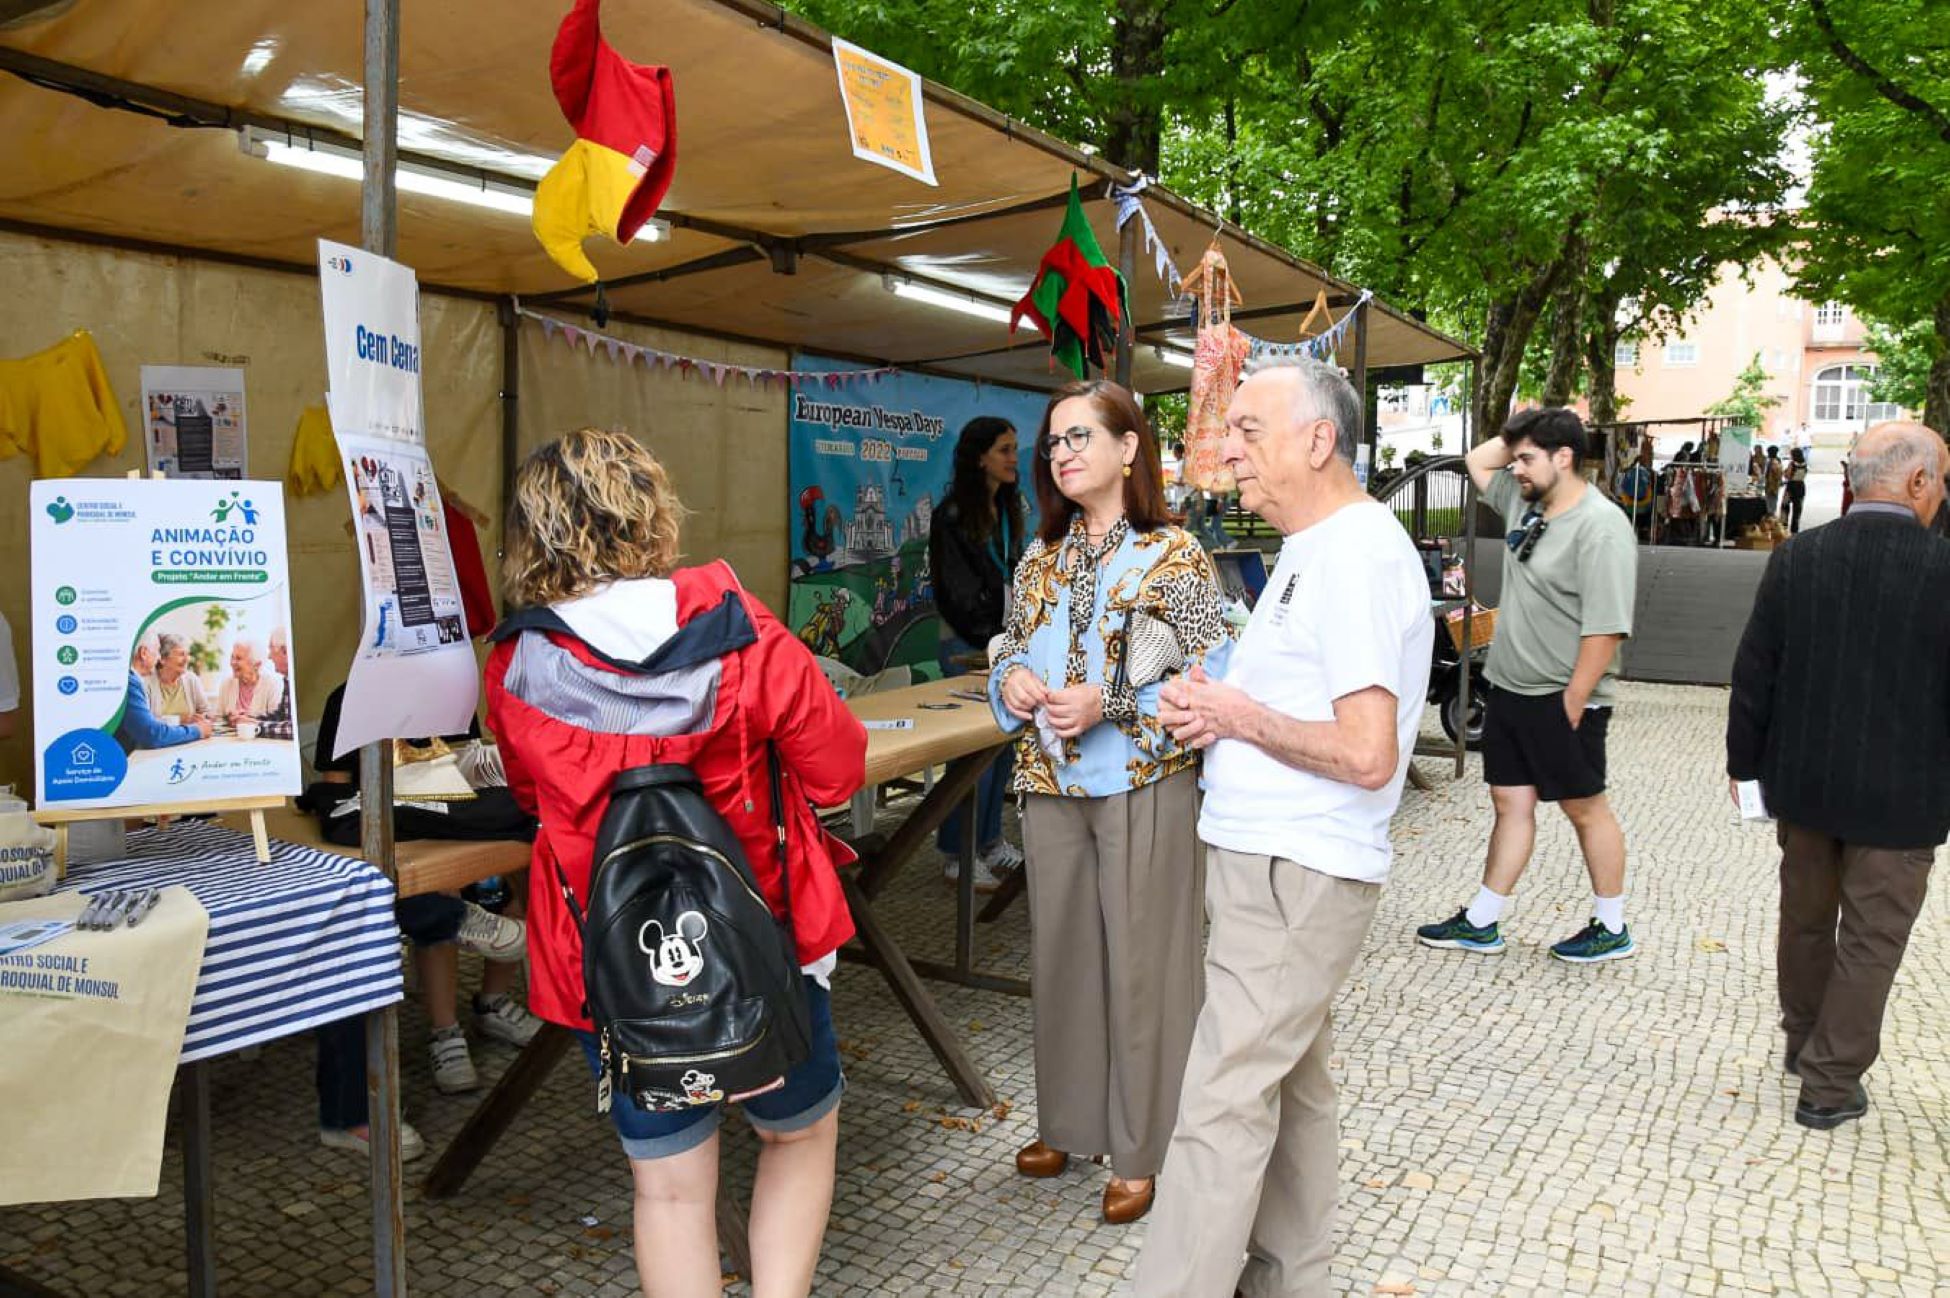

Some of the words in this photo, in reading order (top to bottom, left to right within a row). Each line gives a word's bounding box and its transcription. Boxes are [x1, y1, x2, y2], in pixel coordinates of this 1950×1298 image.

[356, 324, 388, 365] Cem
[796, 394, 872, 431] European
[872, 407, 913, 436] Vespa
[913, 411, 944, 438] Days
[861, 441, 891, 461] 2022
[151, 525, 255, 548] ANIMAÇÃO
[151, 550, 163, 566] E
[169, 547, 268, 566] CONVÍVIO
[37, 954, 79, 973] SOCIAL
[81, 958, 89, 974] E
[57, 975, 73, 993] DE
[75, 976, 120, 999] MONSUL
